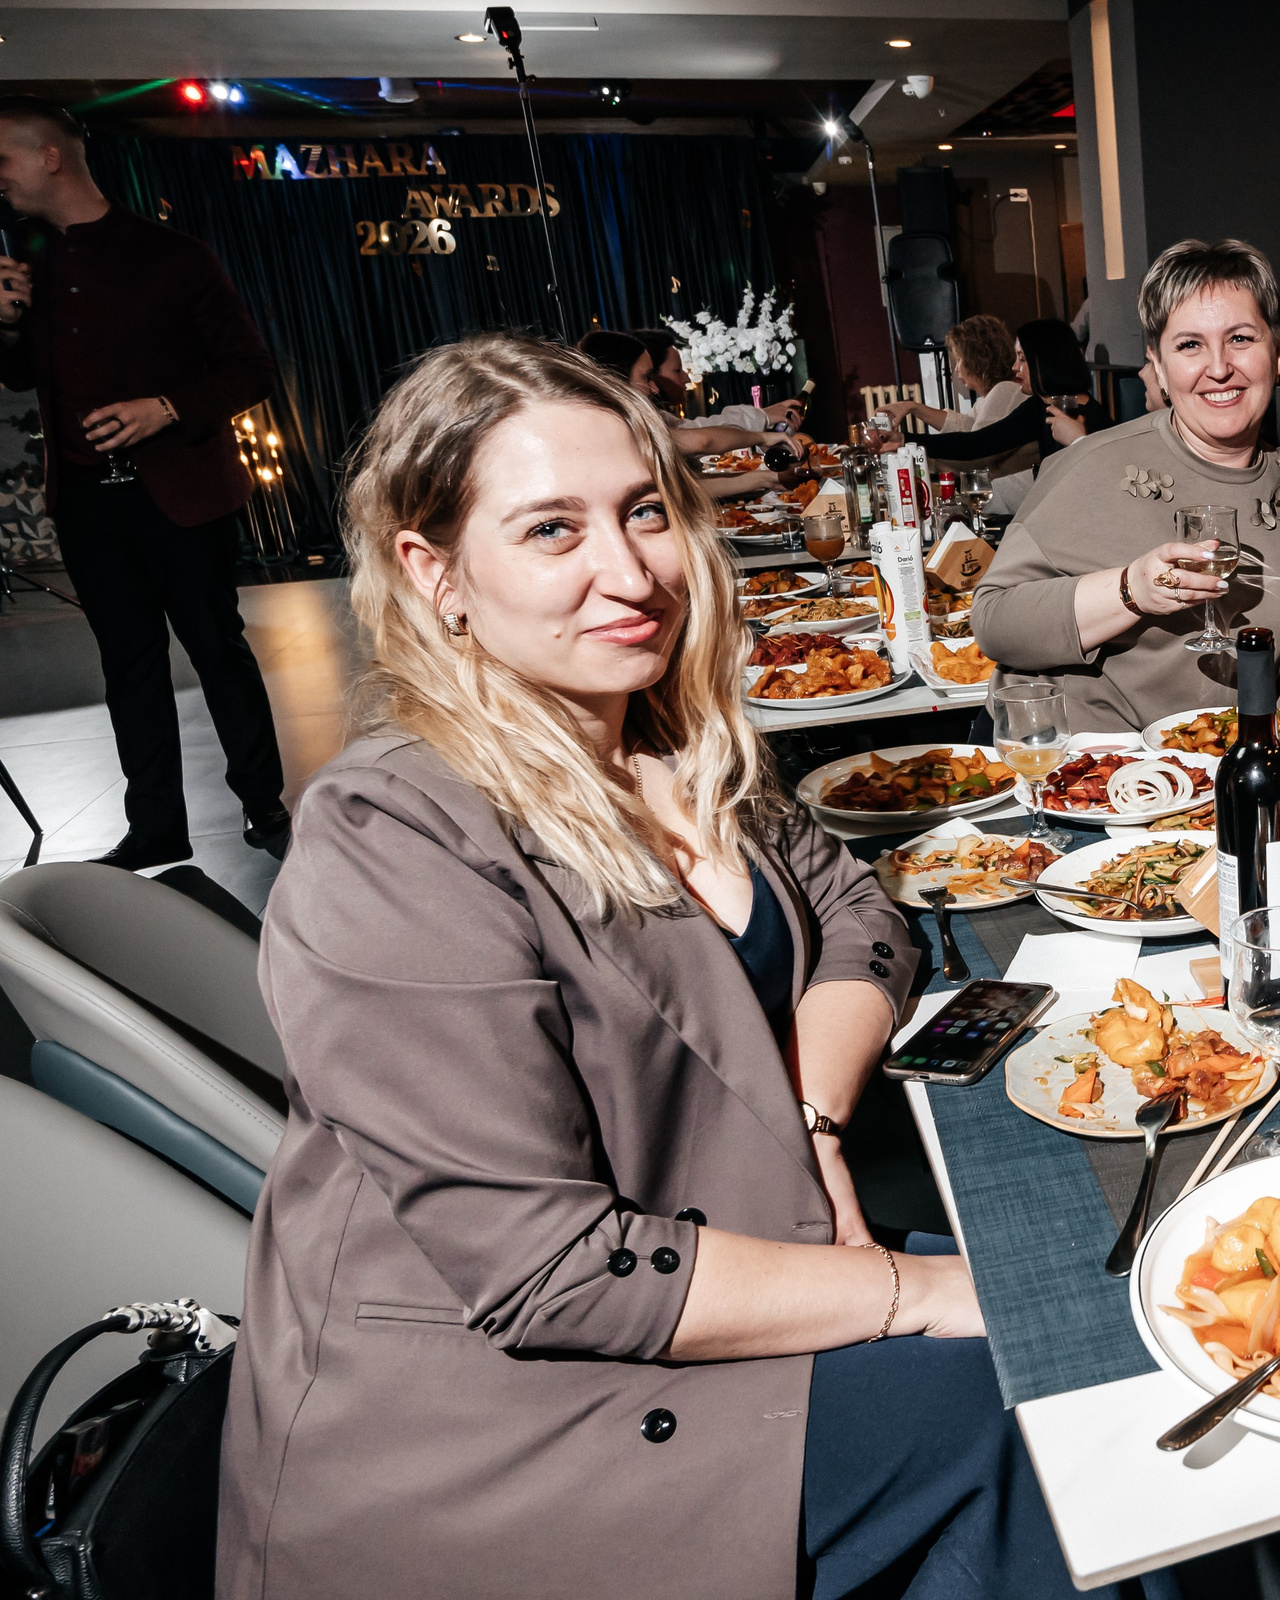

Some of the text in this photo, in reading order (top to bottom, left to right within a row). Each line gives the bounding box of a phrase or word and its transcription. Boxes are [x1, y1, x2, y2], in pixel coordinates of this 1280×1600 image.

[232, 143, 447, 180] MAZHARA
[401, 183, 561, 218] AWARDS
[356, 218, 456, 256] 2026
